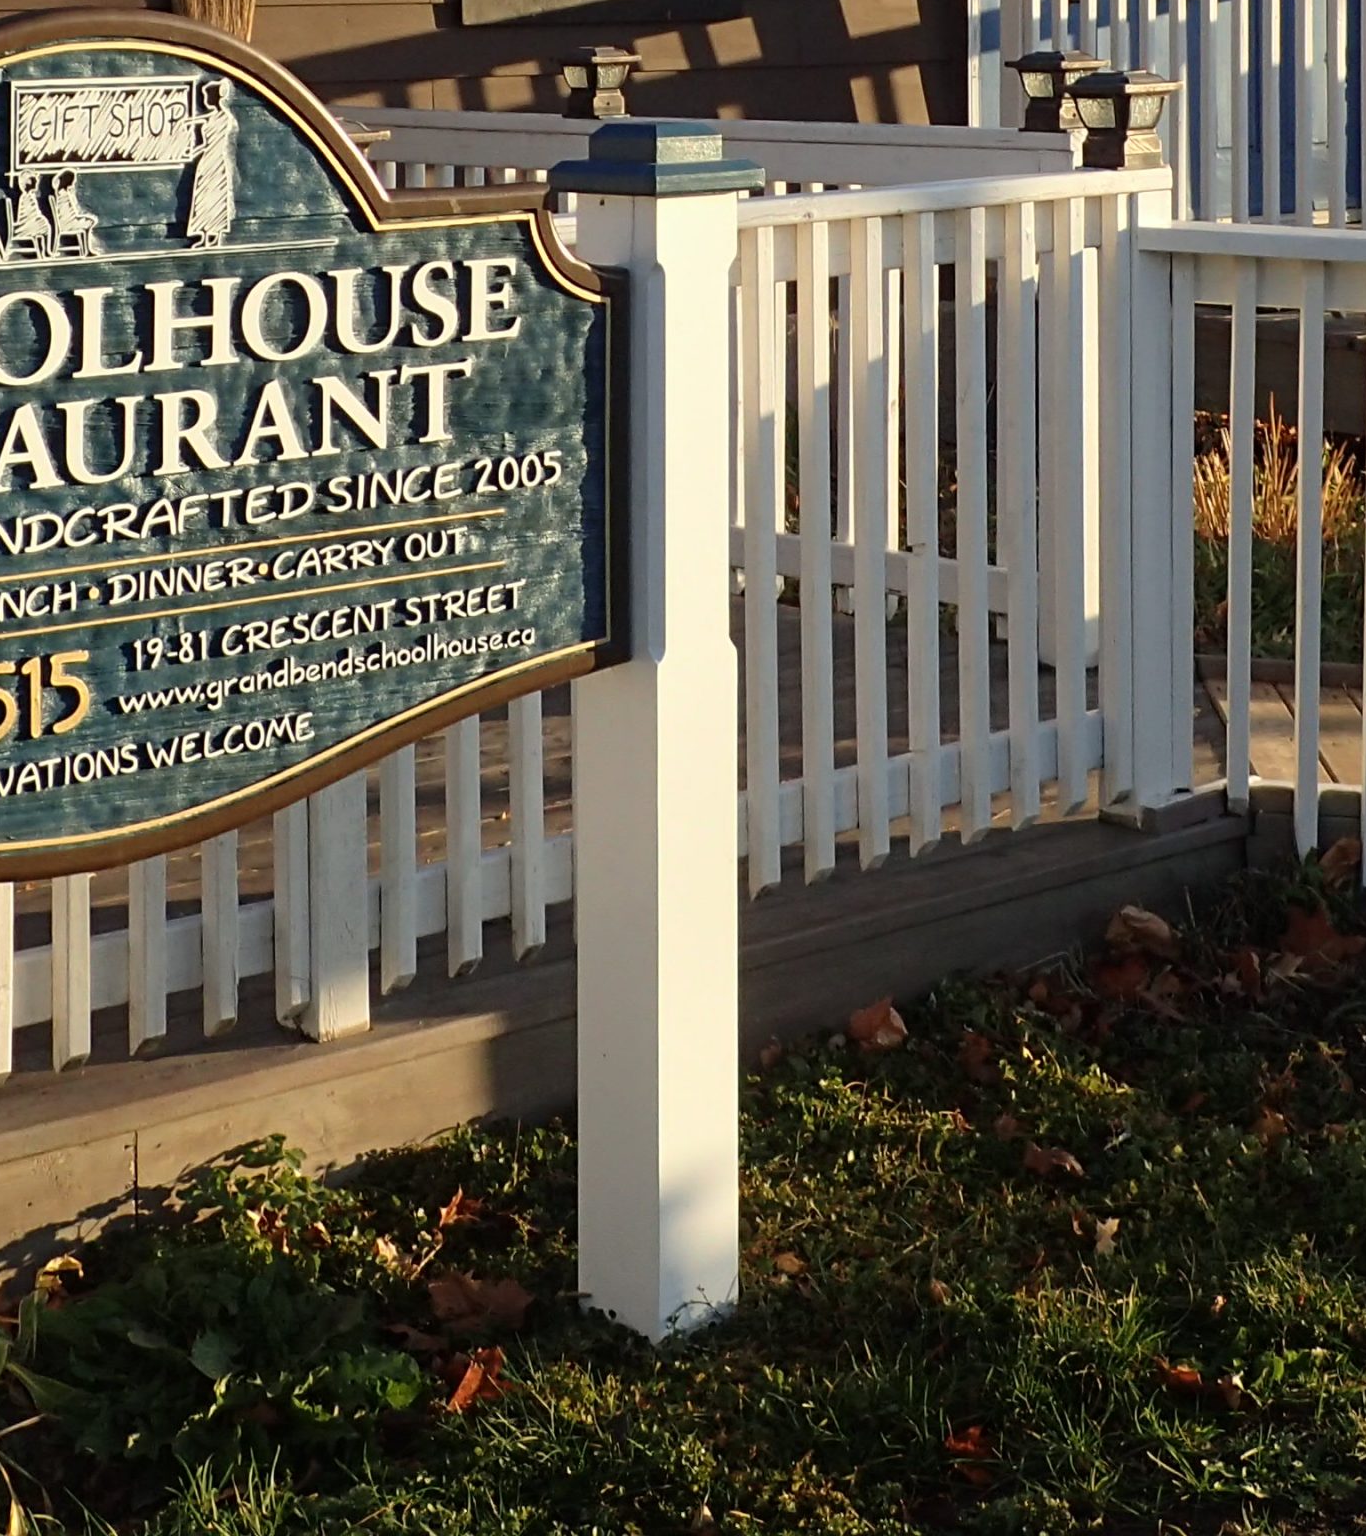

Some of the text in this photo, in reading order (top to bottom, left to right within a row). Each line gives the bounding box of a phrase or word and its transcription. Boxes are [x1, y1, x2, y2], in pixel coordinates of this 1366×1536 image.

[29, 101, 186, 141] GIFT SHOP
[326, 462, 464, 513] SINCE
[475, 450, 562, 494] 2005
[404, 526, 468, 562] OUT
[133, 578, 526, 671] 19-81 CRESCENT STREET
[118, 628, 536, 714] www.grandbendschoolhouse.ca
[146, 712, 315, 768] WELCOME
